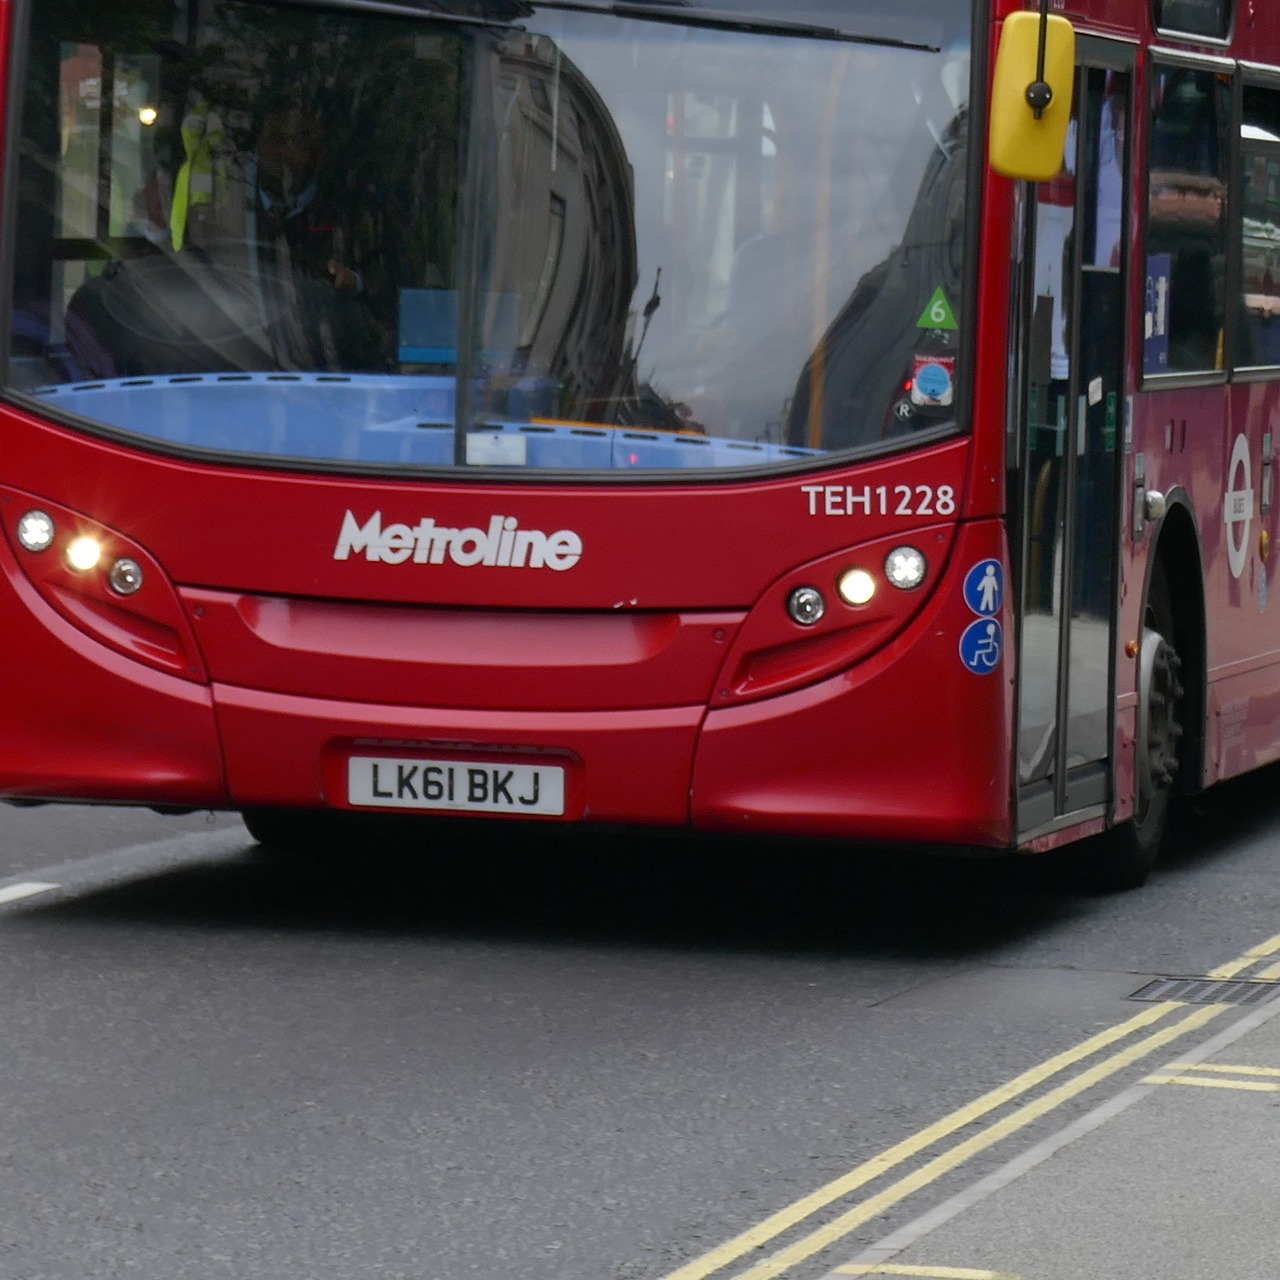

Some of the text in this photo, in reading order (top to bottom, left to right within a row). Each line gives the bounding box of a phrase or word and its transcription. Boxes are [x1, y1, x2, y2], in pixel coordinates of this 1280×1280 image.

[930, 299, 946, 323] 6
[800, 484, 955, 516] TEH1228
[333, 508, 583, 572] Metroline
[372, 763, 540, 806] LK61 BKJ
